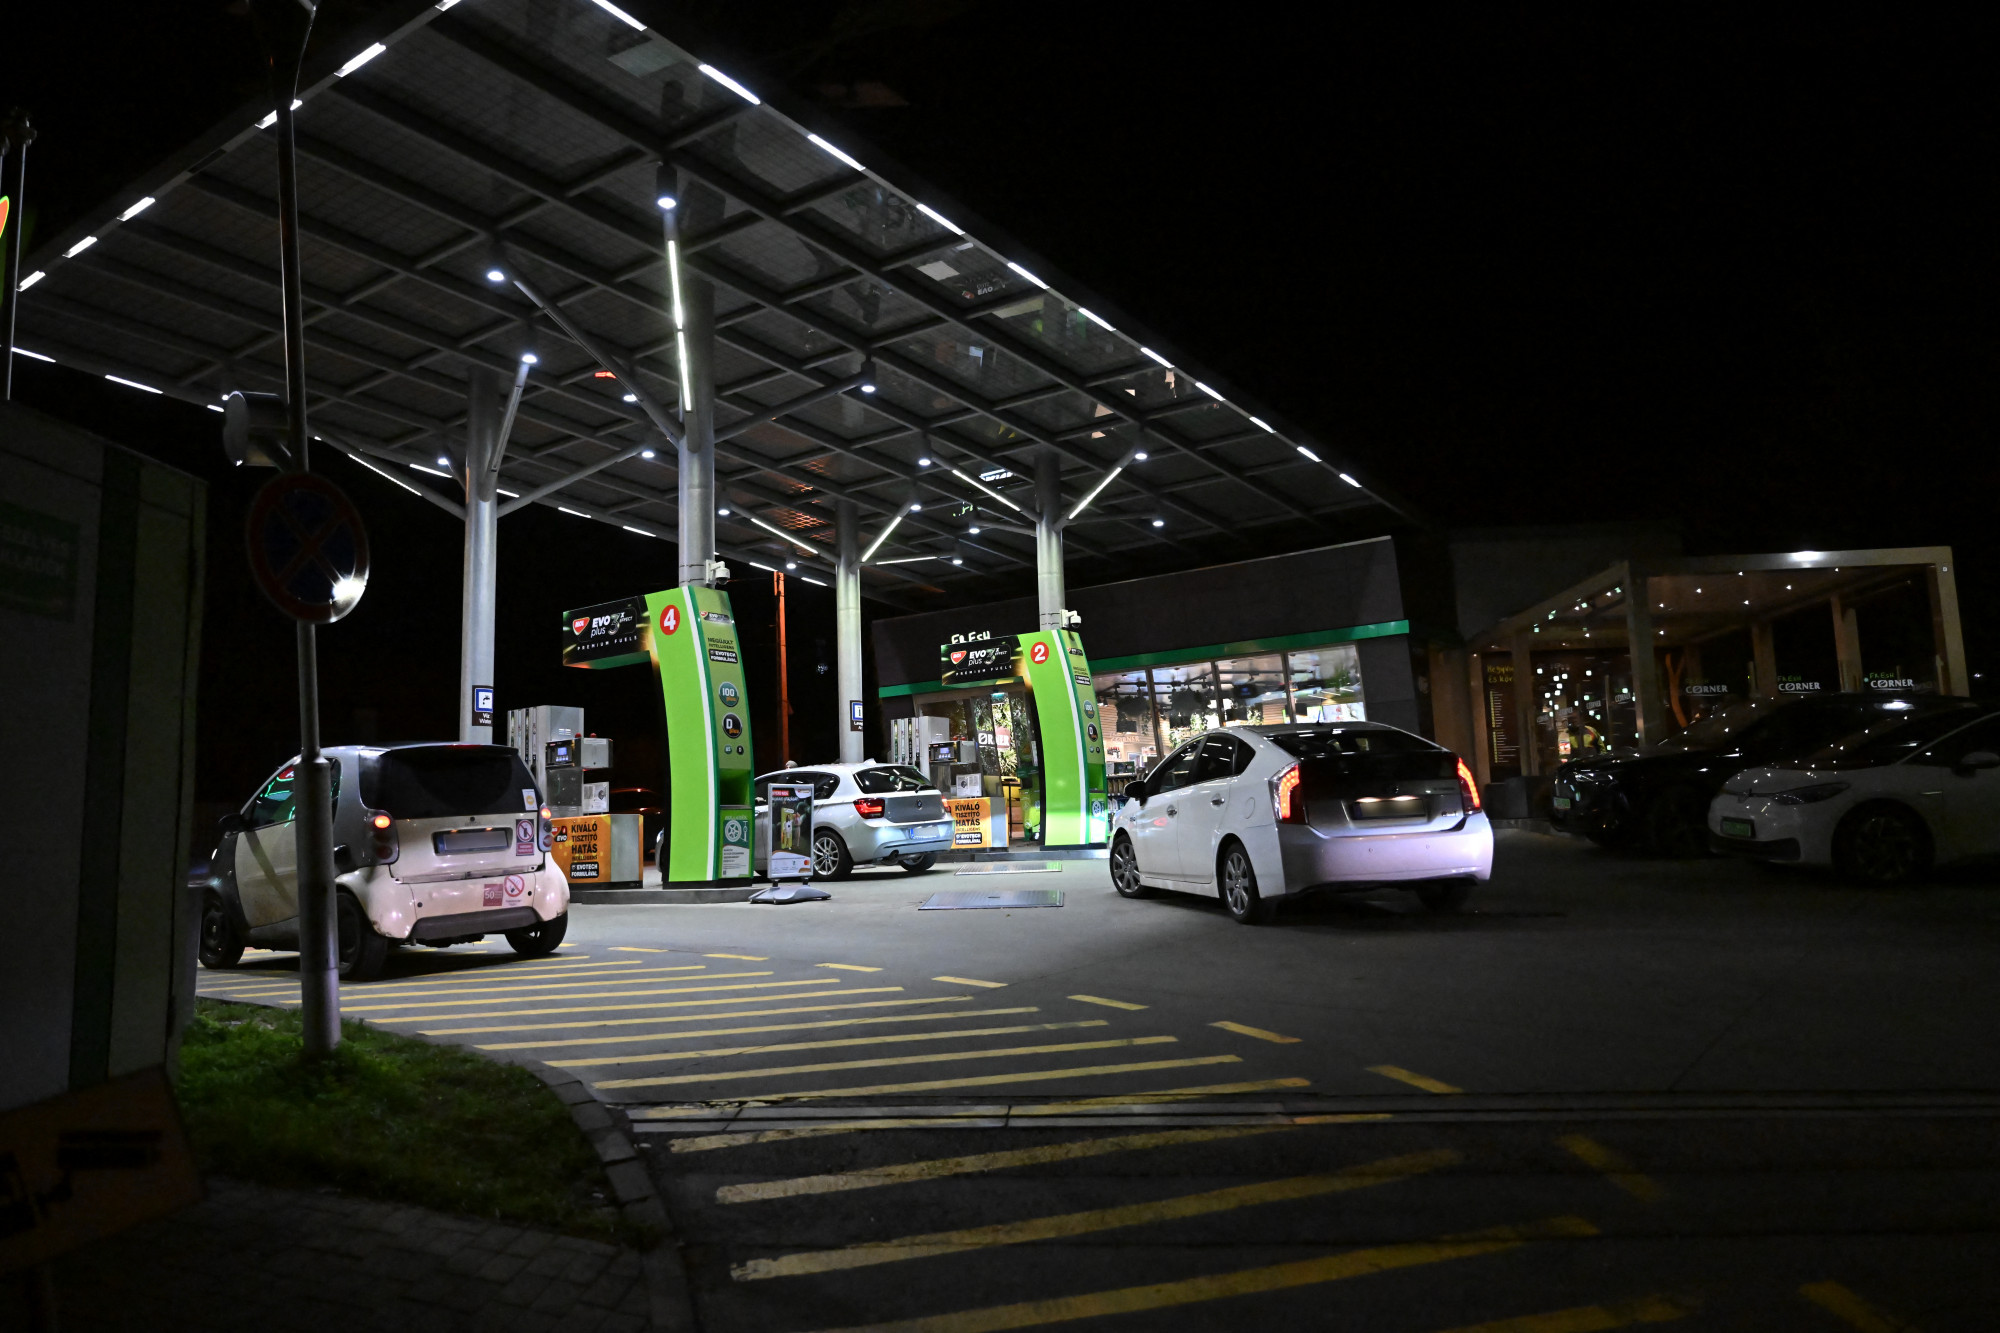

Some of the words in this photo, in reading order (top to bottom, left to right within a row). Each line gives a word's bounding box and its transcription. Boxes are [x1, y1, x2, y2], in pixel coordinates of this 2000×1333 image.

[592, 615, 611, 628] EVO
[663, 608, 677, 630] 4
[590, 627, 606, 638] plus
[577, 641, 609, 651] PREMIUM
[614, 635, 637, 643] FUELS
[969, 650, 987, 659] EVO
[1034, 644, 1046, 662] 2
[968, 658, 983, 667] plus
[955, 668, 986, 676] PREMIUM
[722, 688, 735, 696] 100
[726, 718, 733, 729] D
[955, 802, 980, 811] KIVÁLÓ
[571, 820, 597, 833] KIVÁLÓ
[955, 817, 981, 827] HATÁS
[571, 833, 598, 842] TISZTÍTÓ
[571, 841, 598, 854] HATÁS
[485, 890, 495, 900] 50
